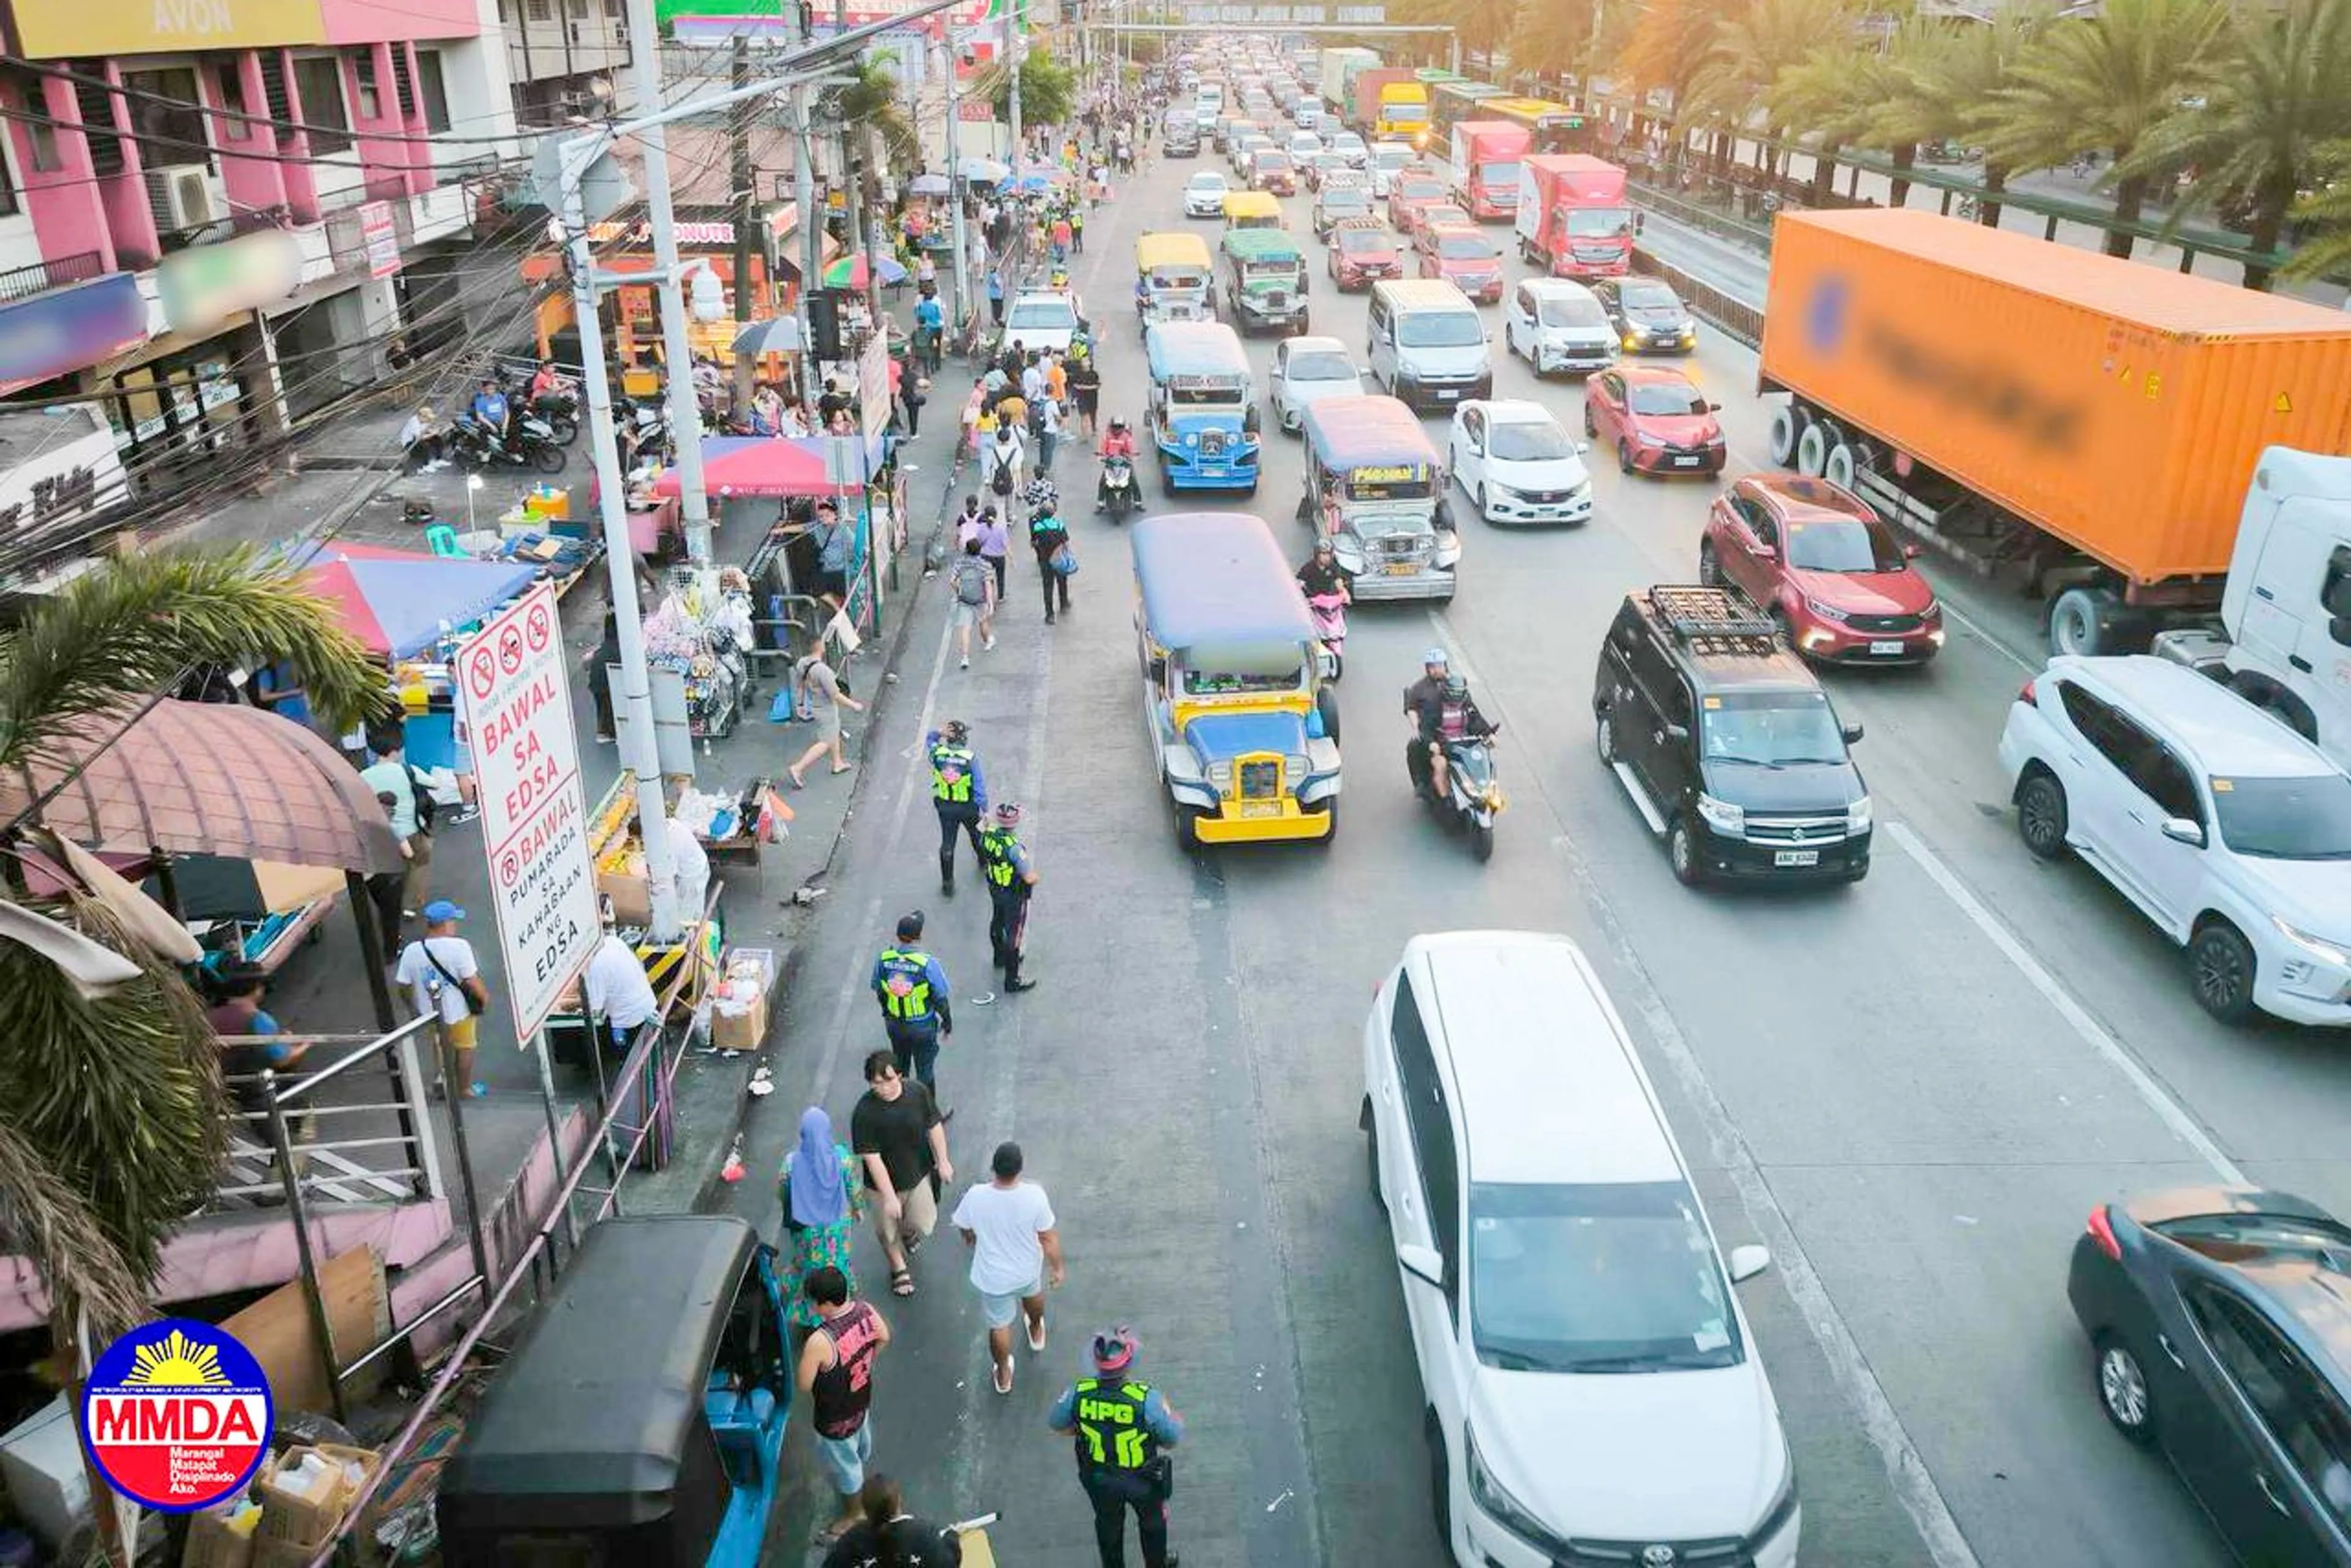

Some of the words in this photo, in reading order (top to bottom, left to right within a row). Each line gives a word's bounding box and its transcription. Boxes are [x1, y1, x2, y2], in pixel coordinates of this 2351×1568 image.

[152, 0, 234, 33] AVON
[673, 223, 733, 242] ONUTS
[482, 673, 557, 757] BAWAL
[514, 729, 541, 771] SA
[506, 755, 558, 823] EDSA
[521, 787, 578, 868] BAWAL
[509, 824, 577, 909] PUMARADA
[541, 875, 557, 899] SA
[518, 865, 582, 949] KAHABAAN
[546, 913, 562, 938] NG
[535, 919, 579, 983] EDSA
[1079, 1398, 1133, 1424] HPG
